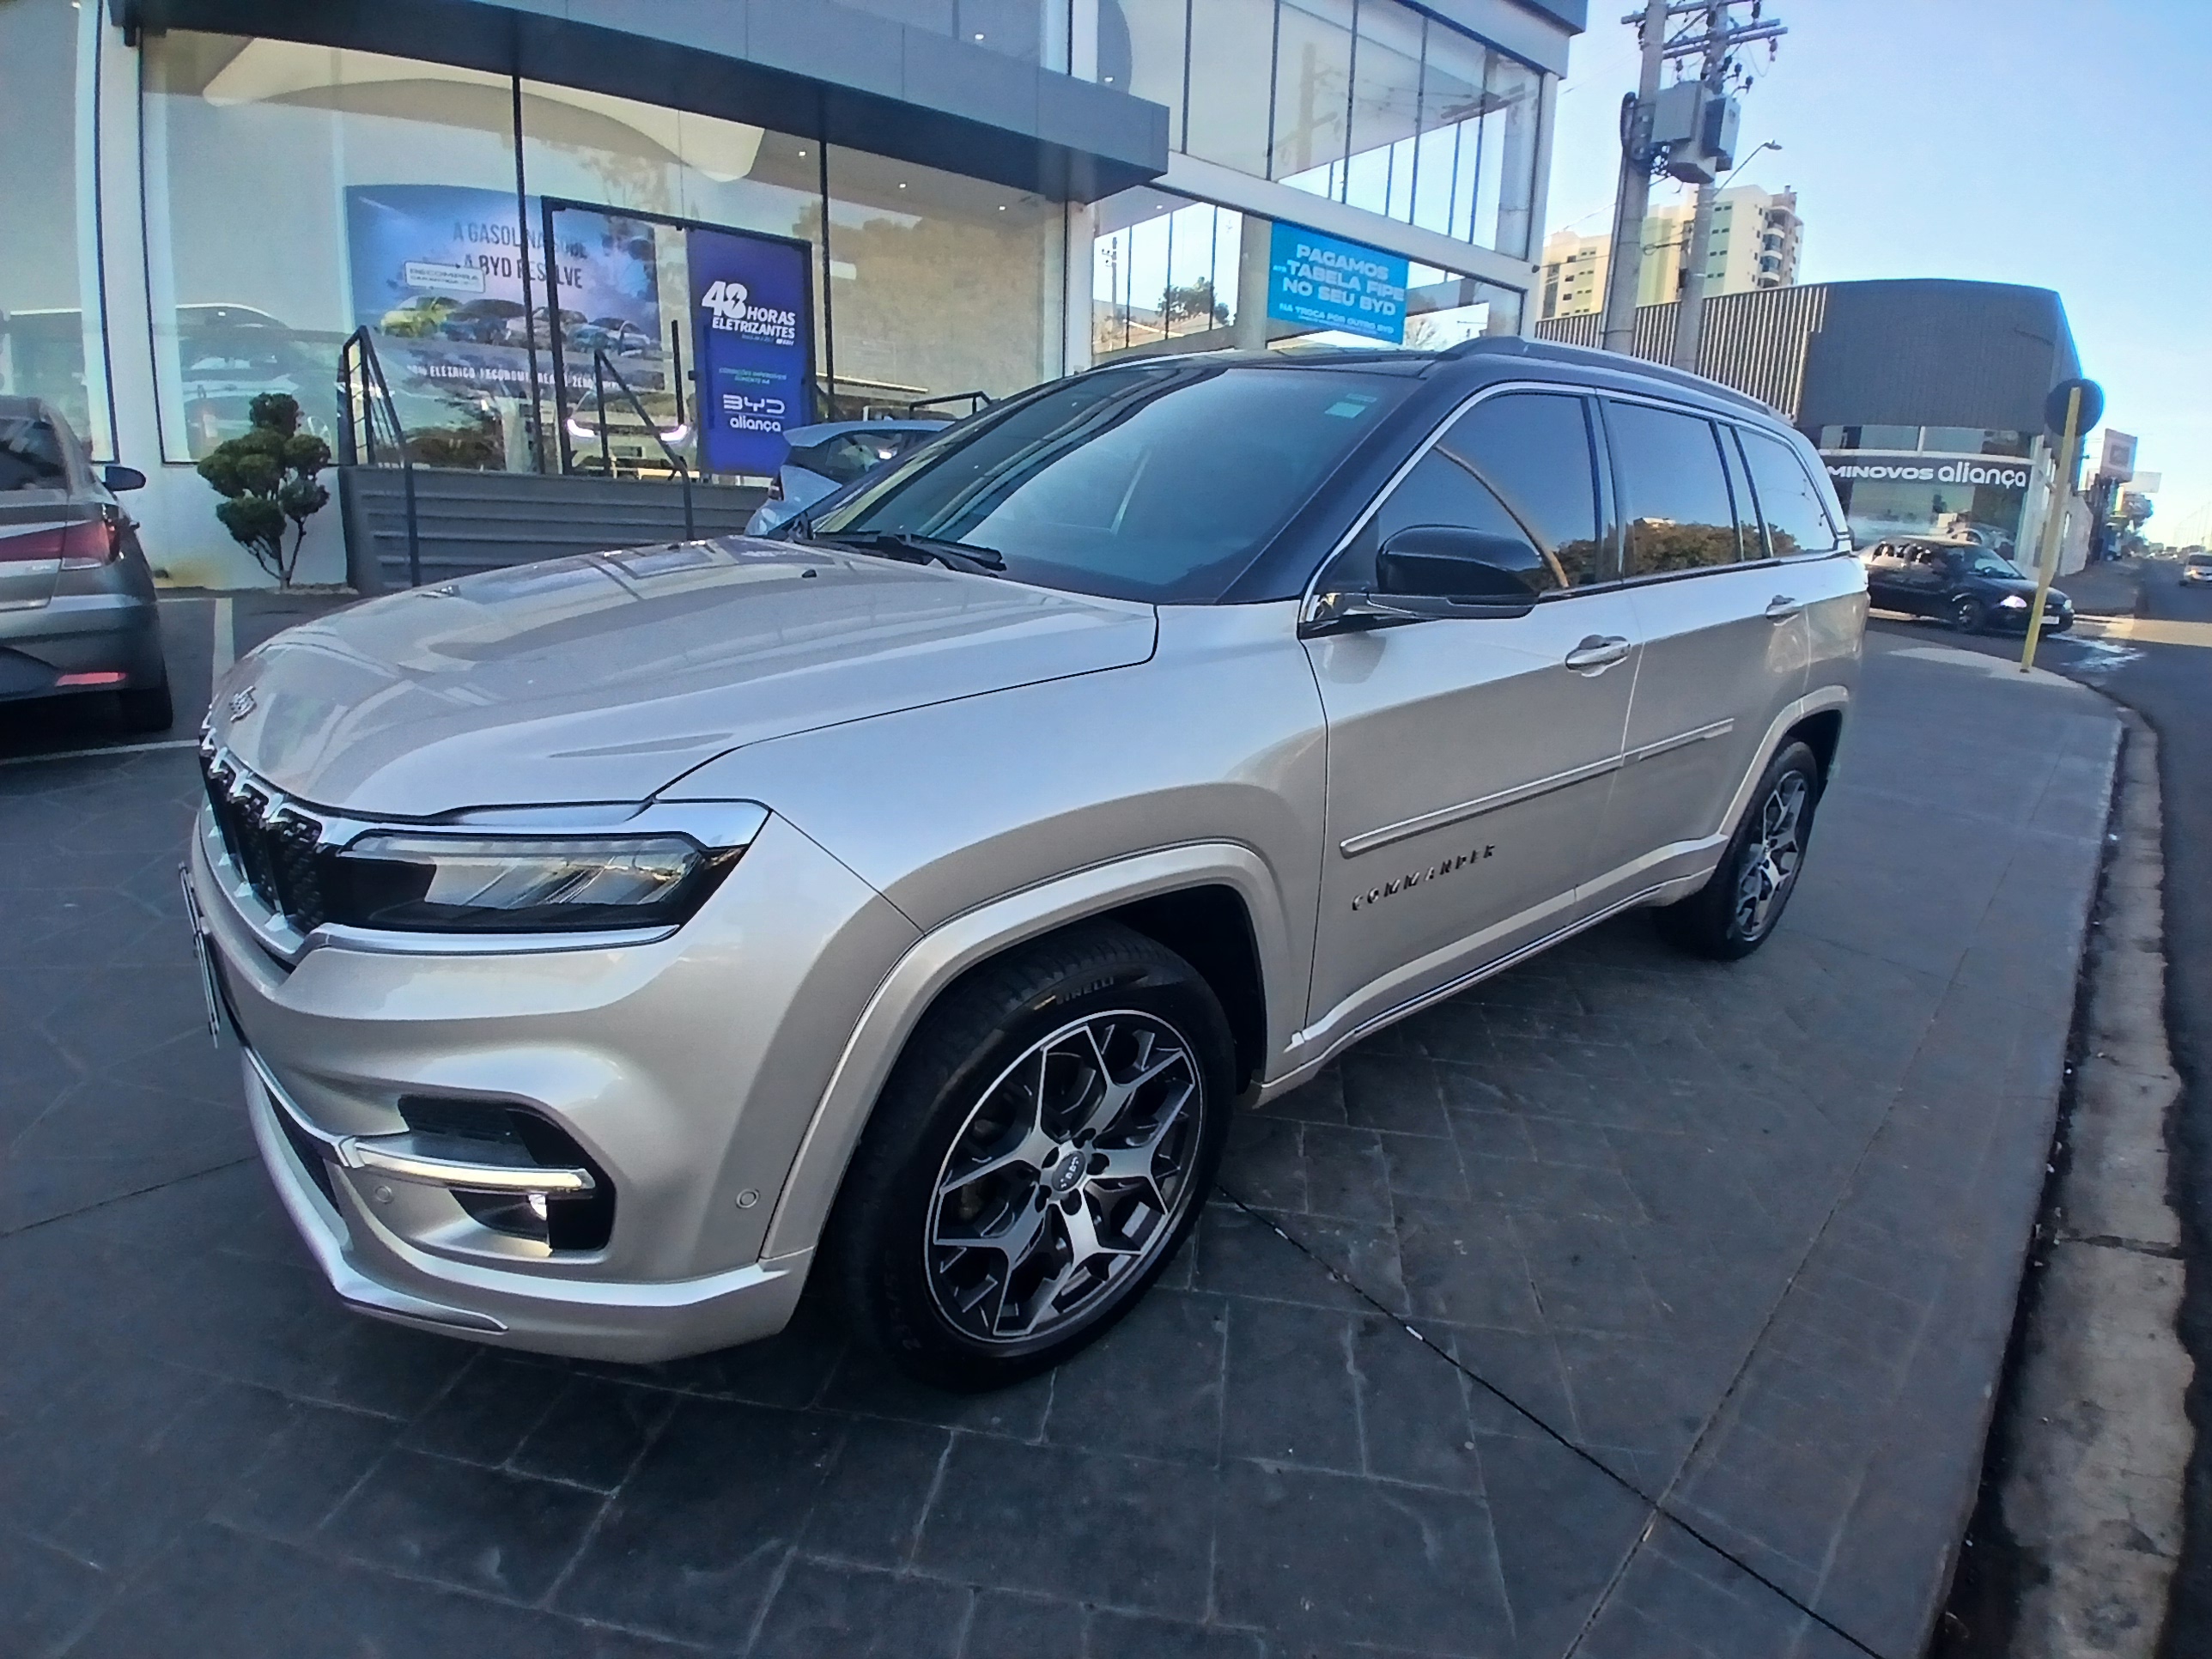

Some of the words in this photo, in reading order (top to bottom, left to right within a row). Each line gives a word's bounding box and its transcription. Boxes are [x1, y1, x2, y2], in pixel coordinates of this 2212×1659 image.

[453, 222, 464, 241] A
[468, 223, 546, 249] GASOLNA
[478, 255, 513, 277] BYD
[517, 258, 583, 289] RESLVE
[1297, 244, 1389, 281] PAGAMOS
[1287, 259, 1361, 292] TABELA
[1366, 281, 1405, 301] FIPE
[702, 281, 748, 319] 48
[747, 306, 796, 325] HORAS
[1283, 277, 1313, 297] NO
[1318, 287, 1355, 307] SEU
[1359, 296, 1396, 316] BYD
[1295, 307, 1325, 319] TROCA
[712, 316, 796, 339] ELETRIZANTES
[485, 368, 532, 382] ECONOMI
[723, 394, 786, 414] BYD
[730, 415, 781, 432] aliança
[1826, 465, 1934, 480] MINOVOS
[1937, 461, 2027, 489] aliança
